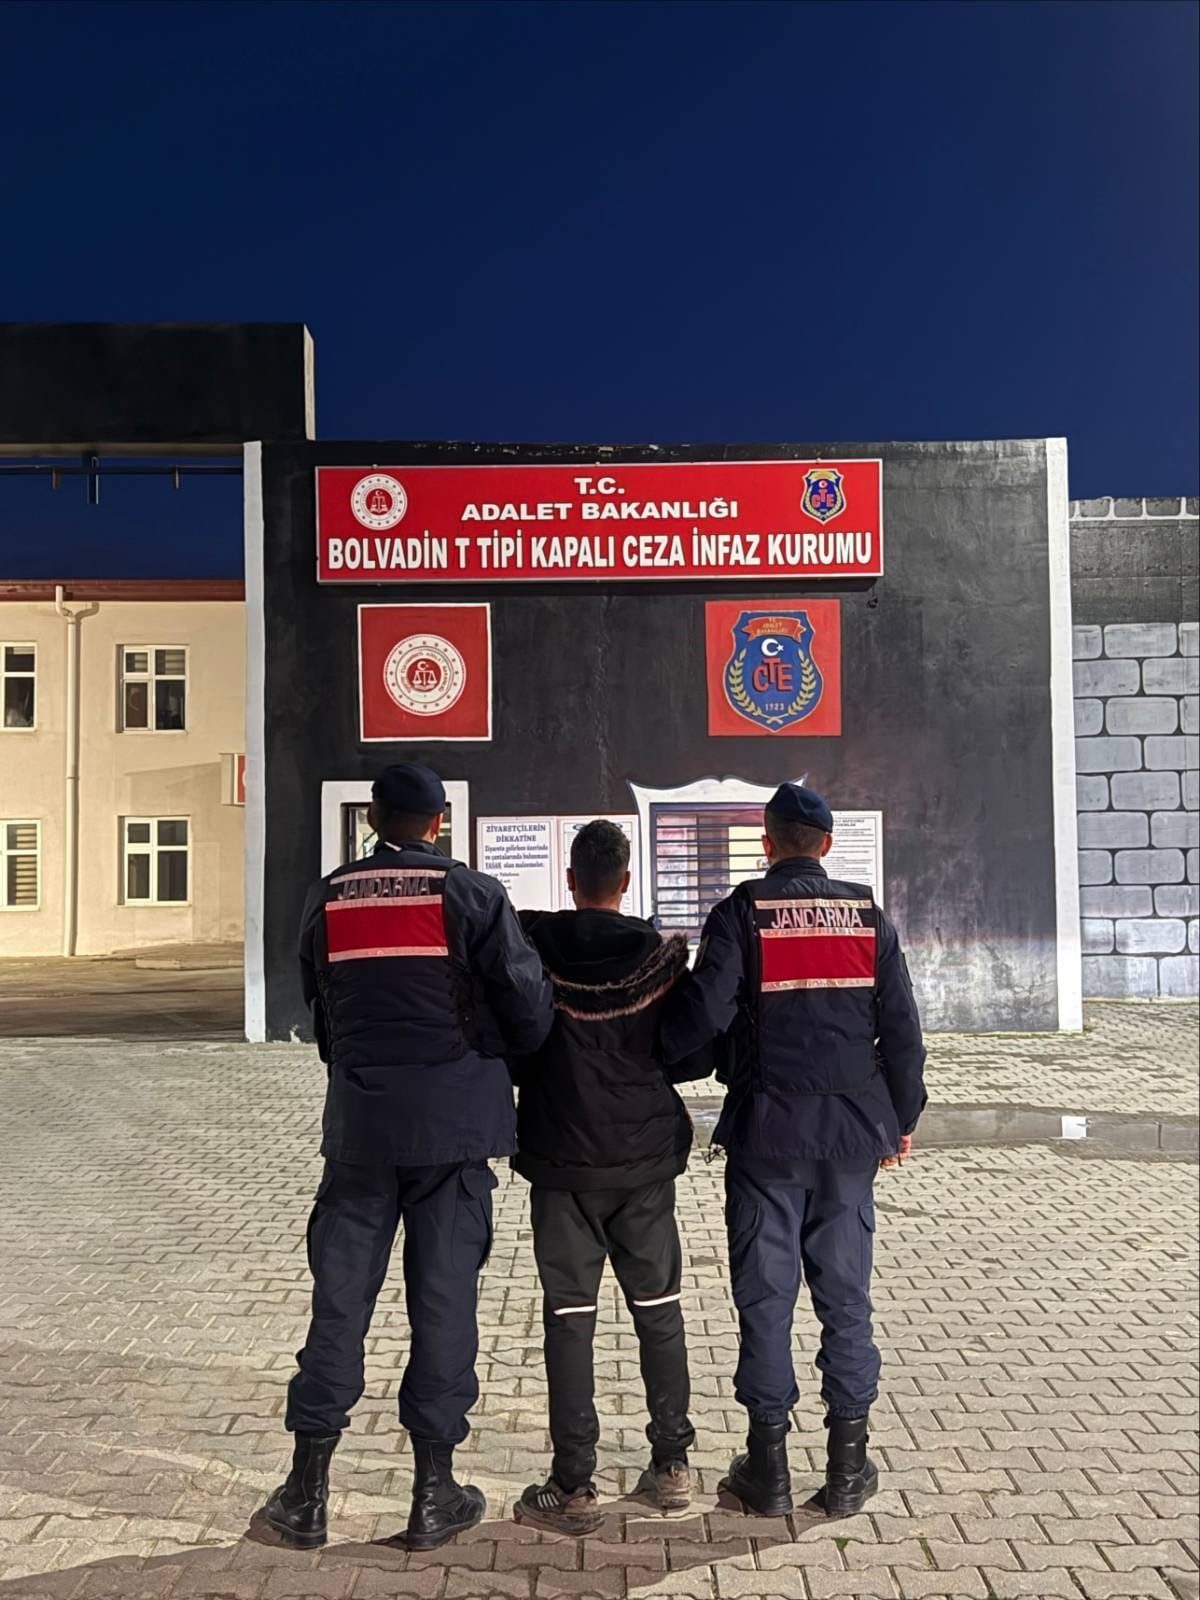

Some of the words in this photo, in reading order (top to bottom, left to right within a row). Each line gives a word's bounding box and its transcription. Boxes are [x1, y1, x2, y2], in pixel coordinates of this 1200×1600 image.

[574, 477, 625, 494] T.C.
[461, 503, 572, 520] ADALET
[582, 497, 738, 519] BAKANLIĞI
[328, 529, 447, 569] BOLVADİN
[454, 536, 470, 569] T
[476, 528, 523, 569] TİPİ
[531, 535, 615, 568] KAPALI
[622, 534, 685, 567] CEZA
[692, 527, 761, 567] İNFAZ
[767, 531, 872, 565] KURUMU
[753, 657, 793, 692] CTE
[486, 824, 546, 833] ZİYARETÇİLERİN
[496, 834, 537, 843] DİKKATİNE
[338, 876, 431, 900] JANDARMA
[771, 907, 863, 929] JANDARMA
